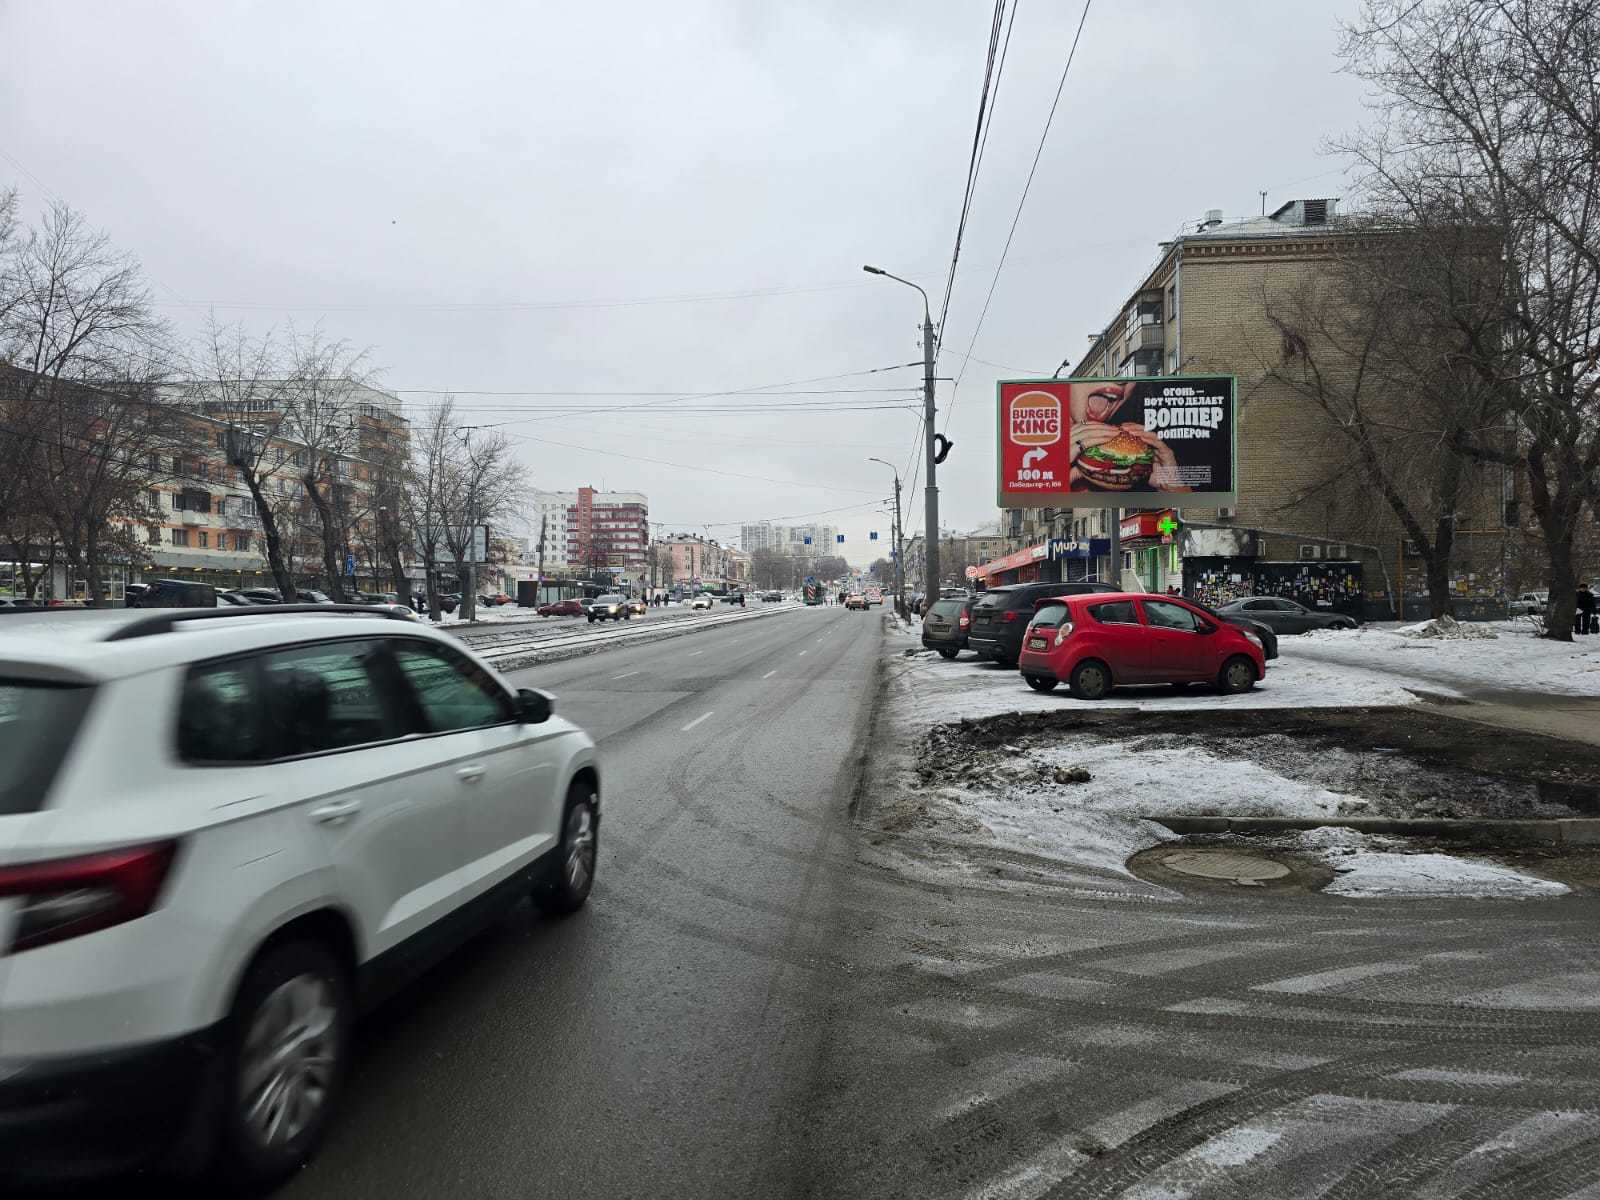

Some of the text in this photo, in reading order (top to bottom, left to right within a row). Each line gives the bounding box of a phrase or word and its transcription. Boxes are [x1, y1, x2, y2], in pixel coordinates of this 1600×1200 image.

[1163, 387, 1195, 396] ОГОНЬ
[1144, 396, 1225, 406] ВОТ ЧТО ДЕЛАЕТ
[1012, 408, 1058, 419] BURGER
[1144, 407, 1224, 432] ВОППЕР
[1012, 419, 1058, 434] KING
[1017, 469, 1041, 480] 100
